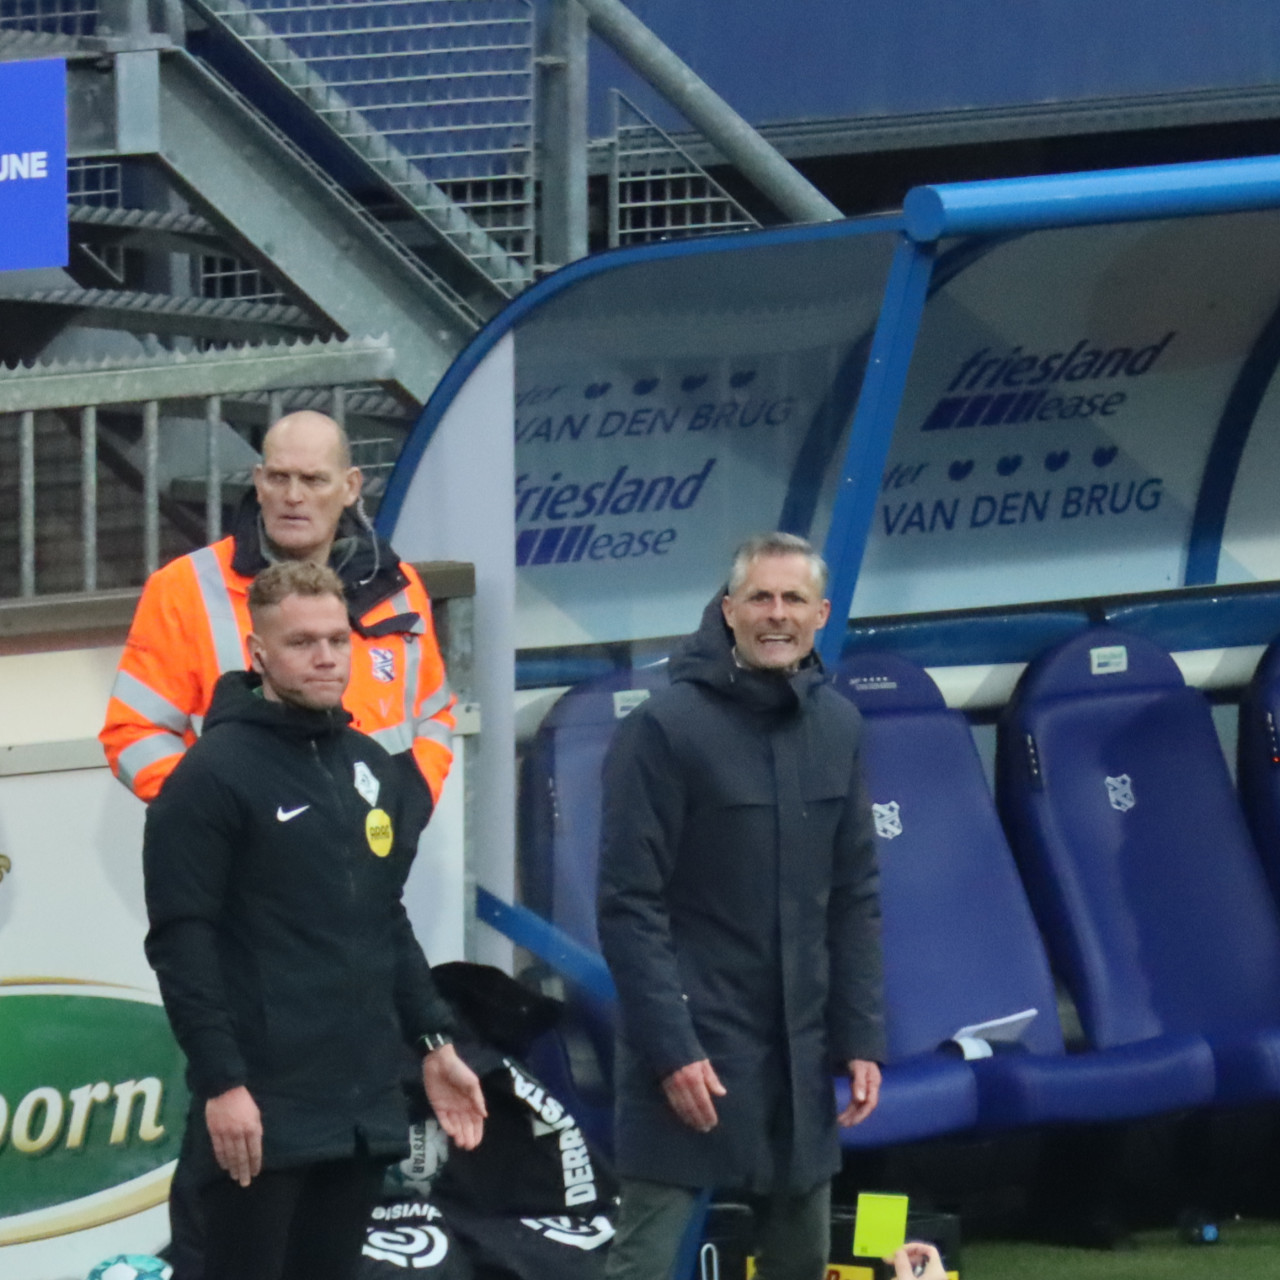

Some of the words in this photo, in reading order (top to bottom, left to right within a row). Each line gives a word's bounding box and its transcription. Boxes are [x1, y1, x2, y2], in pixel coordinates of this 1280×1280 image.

[946, 330, 1178, 394] friesland
[595, 405, 683, 440] DEN
[686, 397, 793, 432] BRUG
[882, 461, 929, 492] ter
[881, 497, 961, 537] VAN
[969, 489, 1051, 529] DEN
[1060, 477, 1165, 521] BRUG
